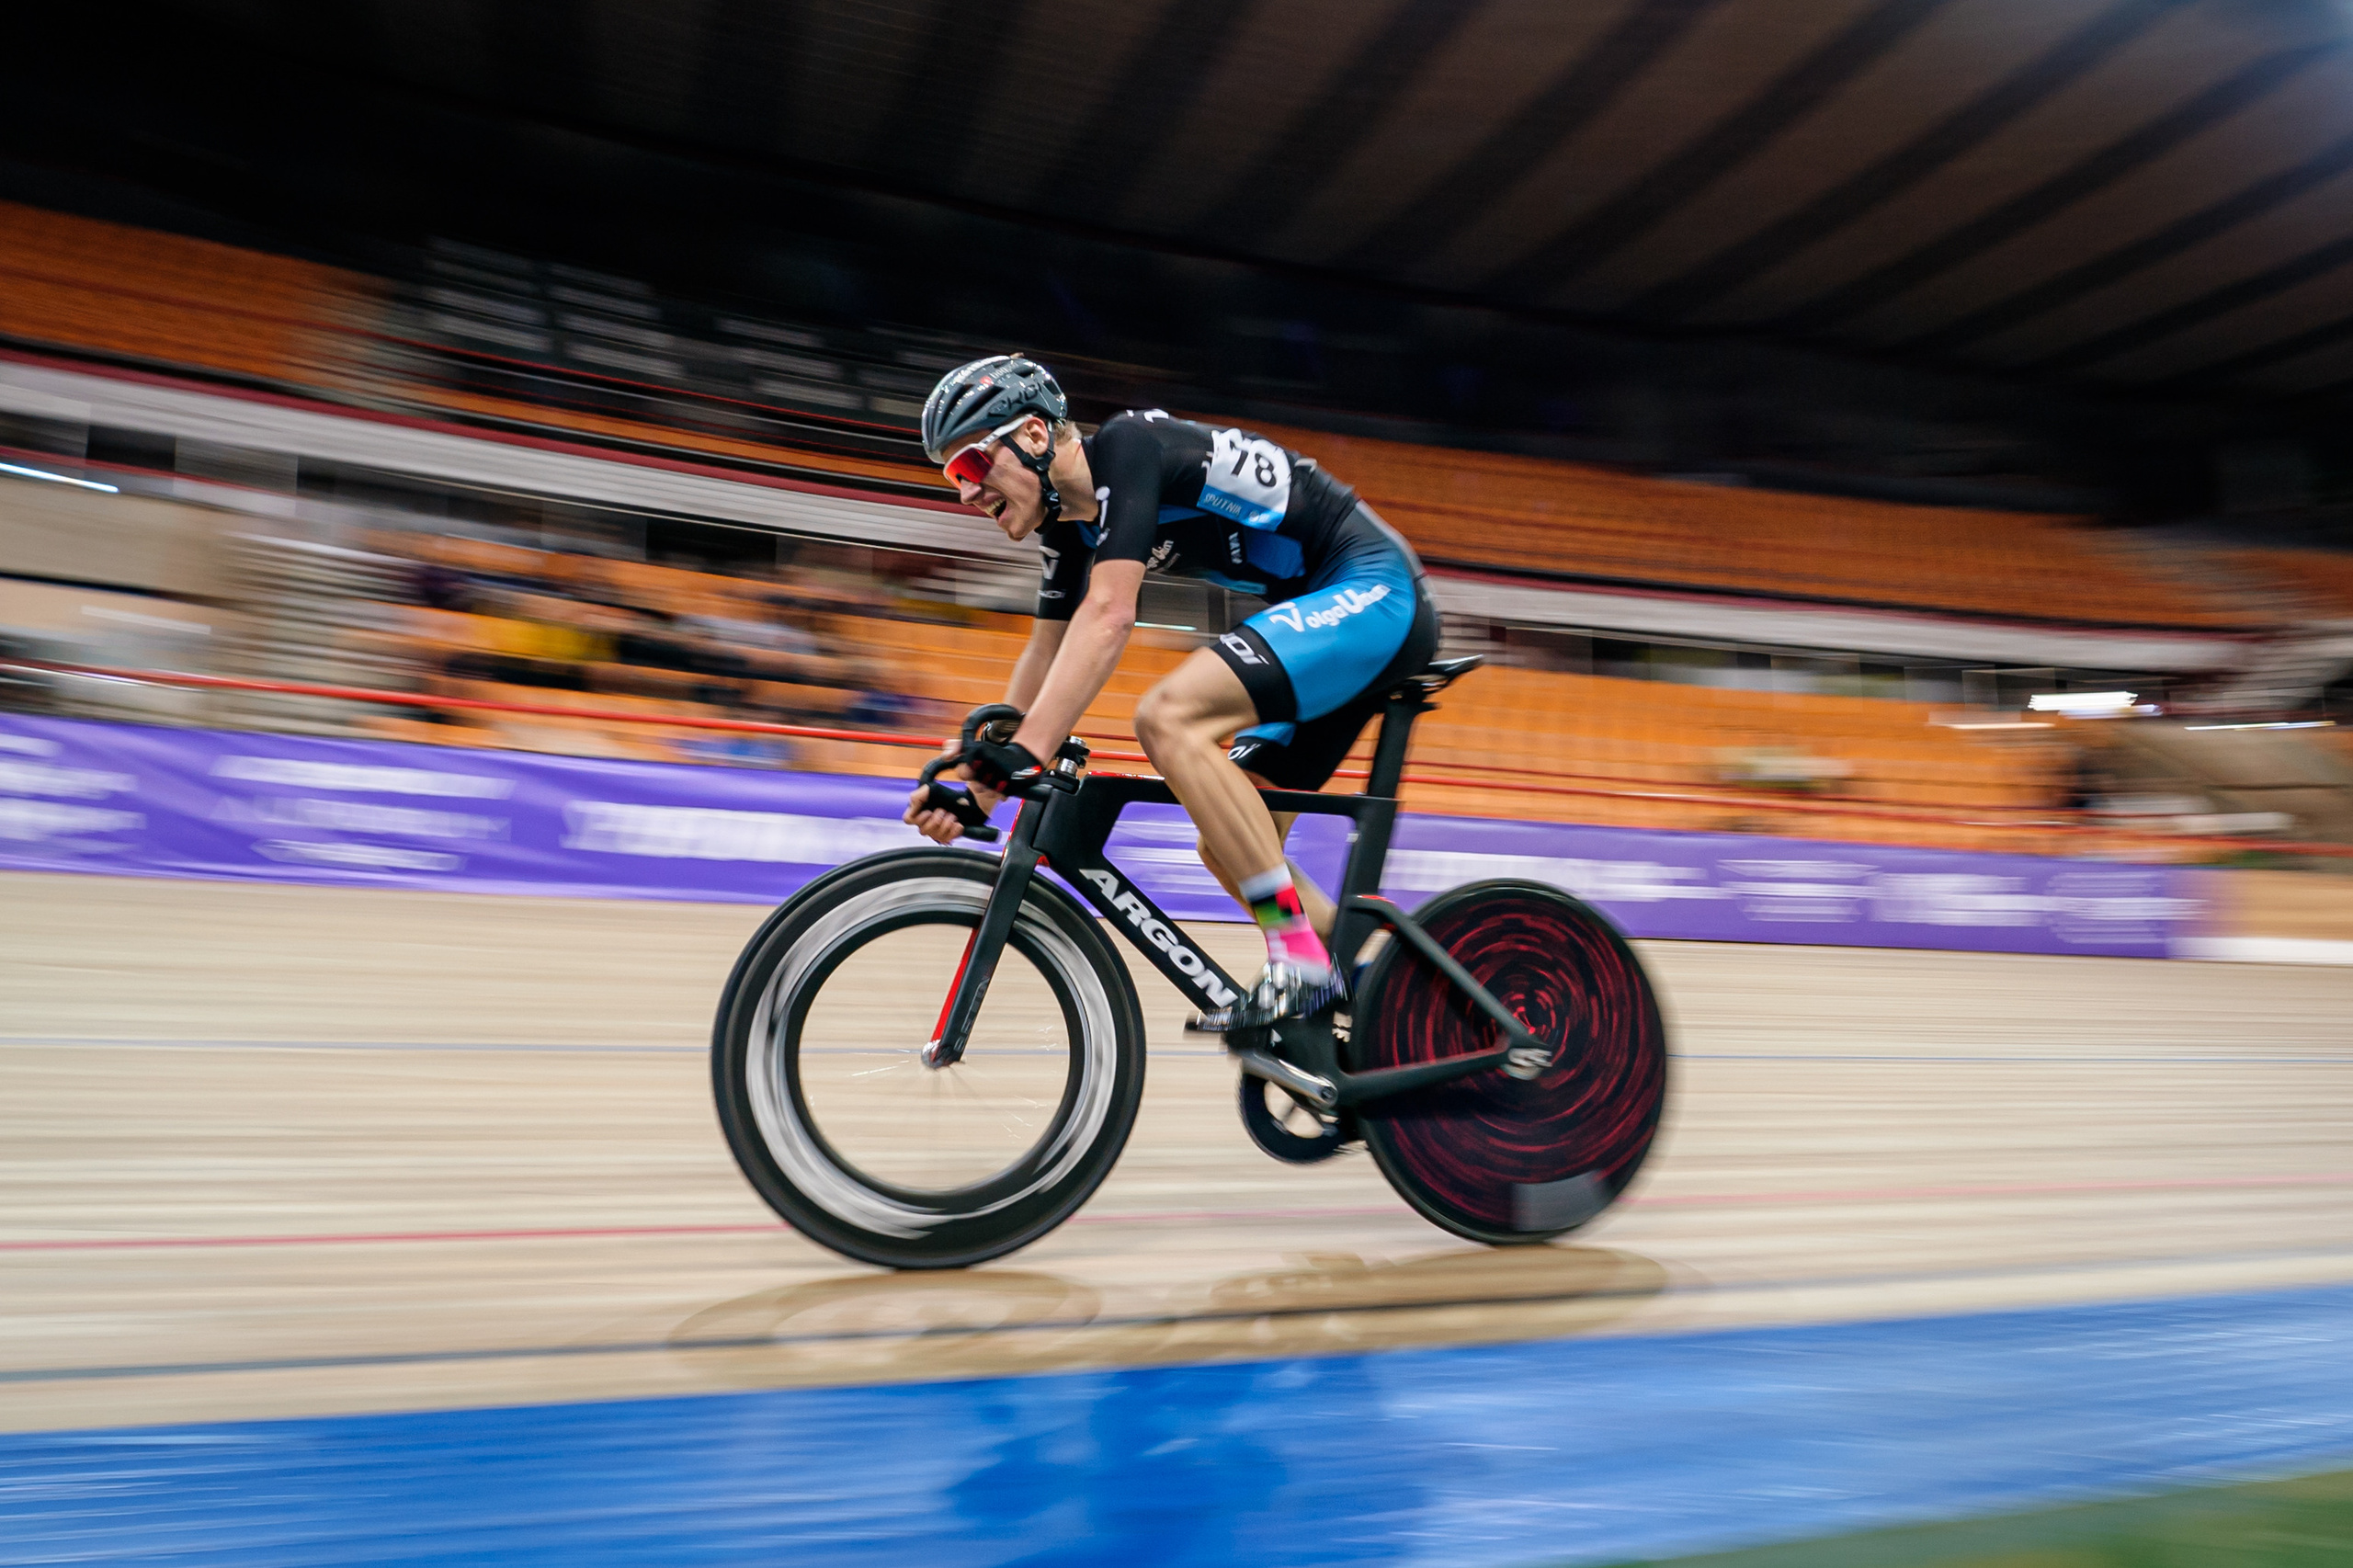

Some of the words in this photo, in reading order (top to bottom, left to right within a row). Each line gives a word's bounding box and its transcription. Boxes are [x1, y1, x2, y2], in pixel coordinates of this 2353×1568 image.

[1228, 438, 1277, 487] 18
[1204, 493, 1243, 517] SPUTNIK
[1079, 869, 1239, 1008] ARGON
